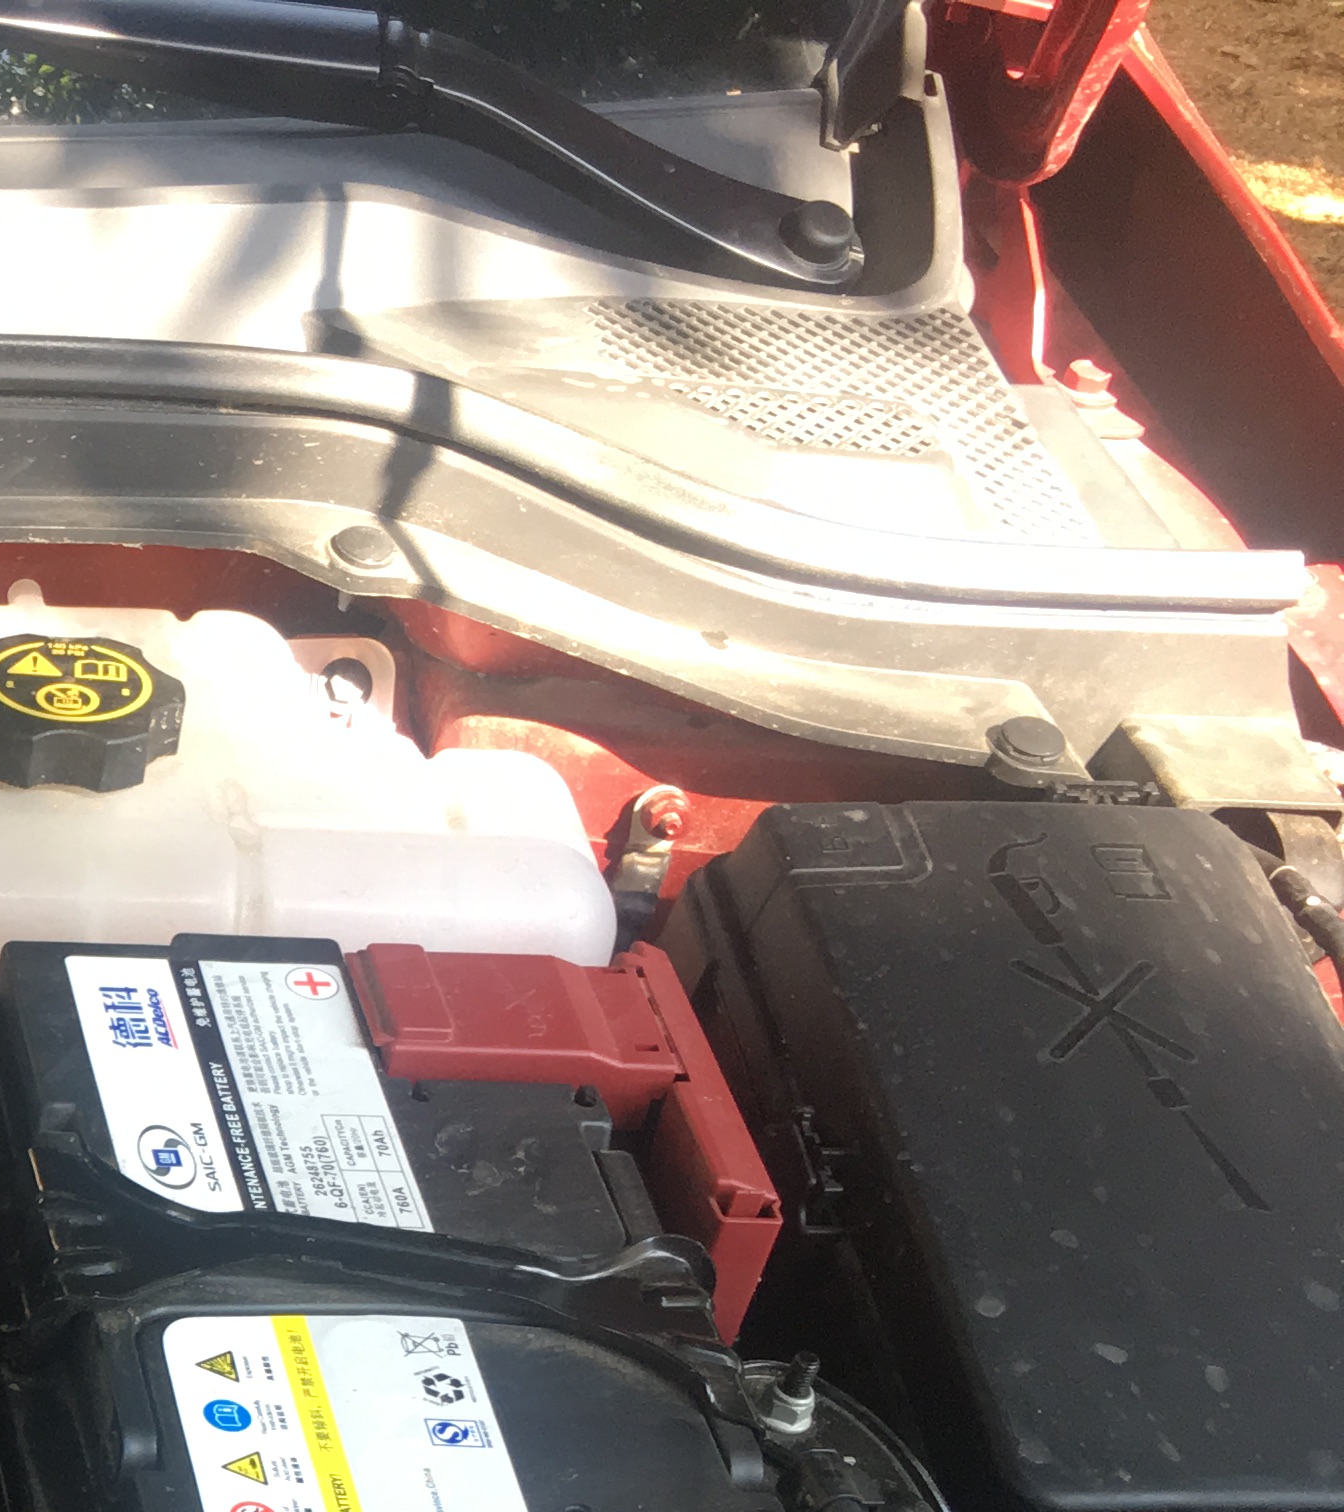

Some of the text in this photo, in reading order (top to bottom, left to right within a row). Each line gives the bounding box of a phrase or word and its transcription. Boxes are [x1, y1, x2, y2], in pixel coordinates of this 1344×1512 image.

[98, 986, 153, 1047] 德科
[155, 988, 173, 1047] ACDelco
[252, 1024, 269, 1052] SAIC-GM
[177, 966, 269, 1209] NTENANCE-FREE BATTERY 免维护蓄电池
[265, 1104, 292, 1150] Technology
[370, 1129, 391, 1156] 70Ah
[188, 1122, 223, 1192] SAIC-GM
[281, 1153, 298, 1174] AGM
[298, 1145, 328, 1197] 26248755
[310, 1135, 351, 1208] 6-QF-70(760)
[391, 1186, 412, 1213] 760A
